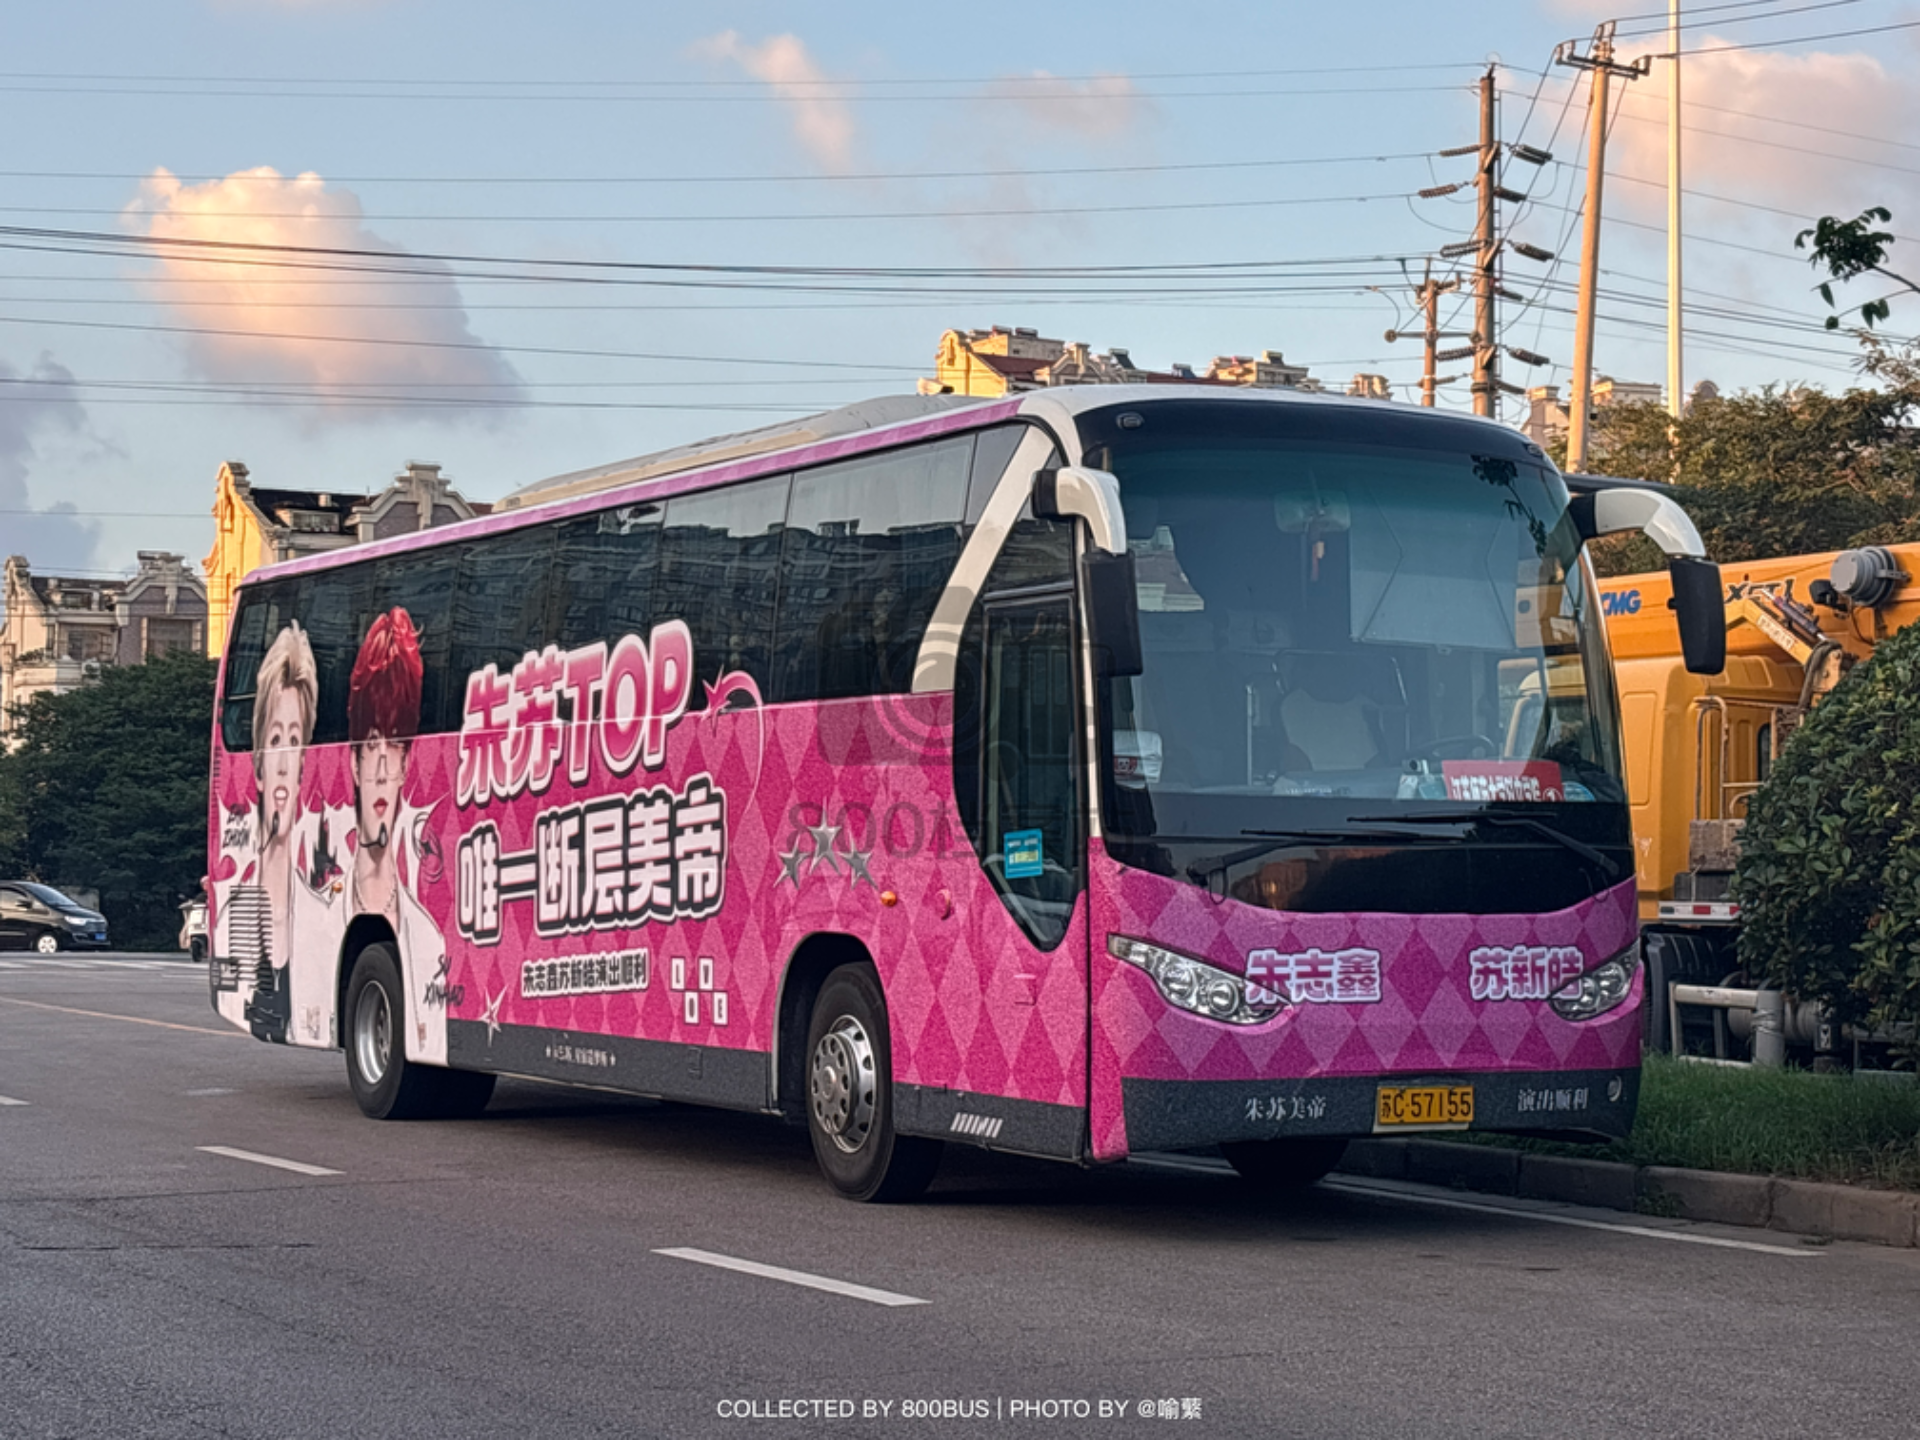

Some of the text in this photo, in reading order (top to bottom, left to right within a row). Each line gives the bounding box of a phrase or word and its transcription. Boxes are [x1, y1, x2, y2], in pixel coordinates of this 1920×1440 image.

[457, 619, 692, 806] 朱苏TOP
[456, 774, 726, 943] 唯一断层美帝
[1247, 950, 1381, 1004] 朱志鑫
[1471, 946, 1584, 1000] 苏新皓
